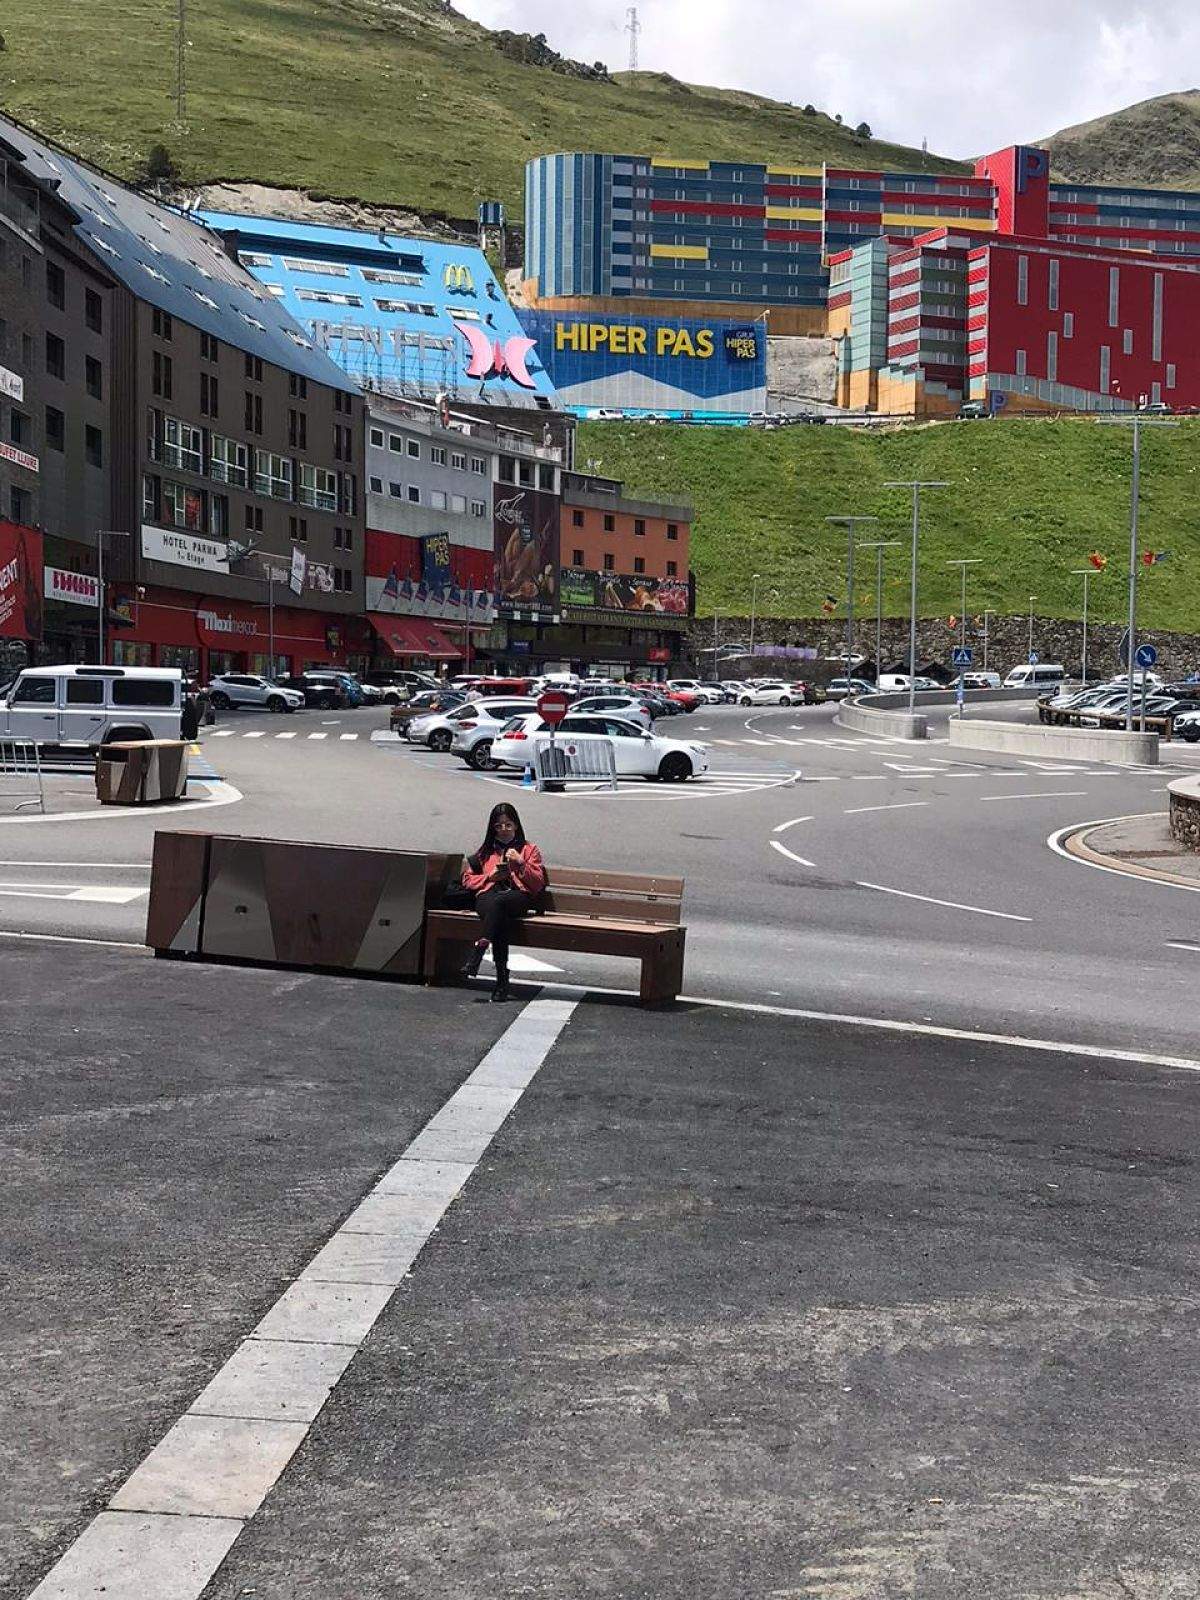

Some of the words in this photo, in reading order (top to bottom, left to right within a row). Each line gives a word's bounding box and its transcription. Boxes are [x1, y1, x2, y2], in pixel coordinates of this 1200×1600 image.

[556, 322, 646, 354] HIPER
[656, 328, 714, 358] PAS
[726, 338, 755, 348] HIPER
[736, 348, 755, 358] PAS
[163, 534, 187, 550] HOTEL
